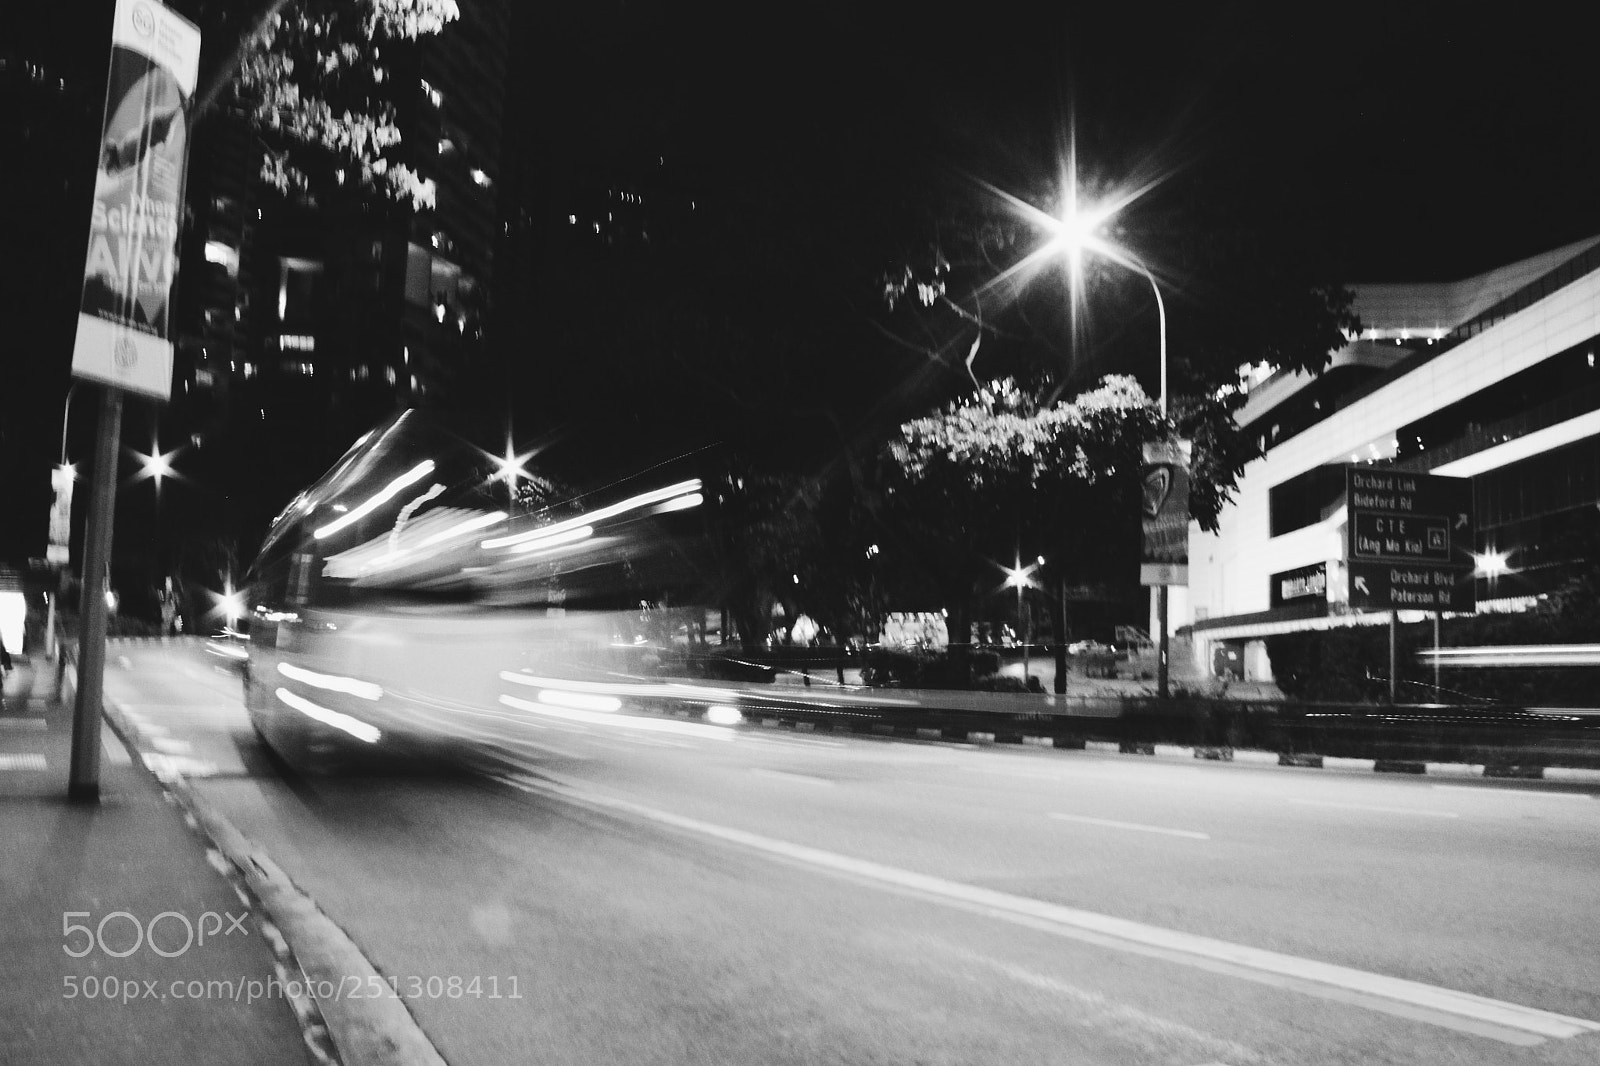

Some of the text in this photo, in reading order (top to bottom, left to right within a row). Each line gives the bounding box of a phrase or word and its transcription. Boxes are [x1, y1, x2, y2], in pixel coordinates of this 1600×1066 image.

[1353, 473, 1416, 492] Orchard Link
[1353, 492, 1412, 511] Bideford Rd
[1386, 538, 1400, 552] Mo
[1390, 569, 1455, 586] Orchard Blvd
[1390, 587, 1451, 604] Paterson Rd
